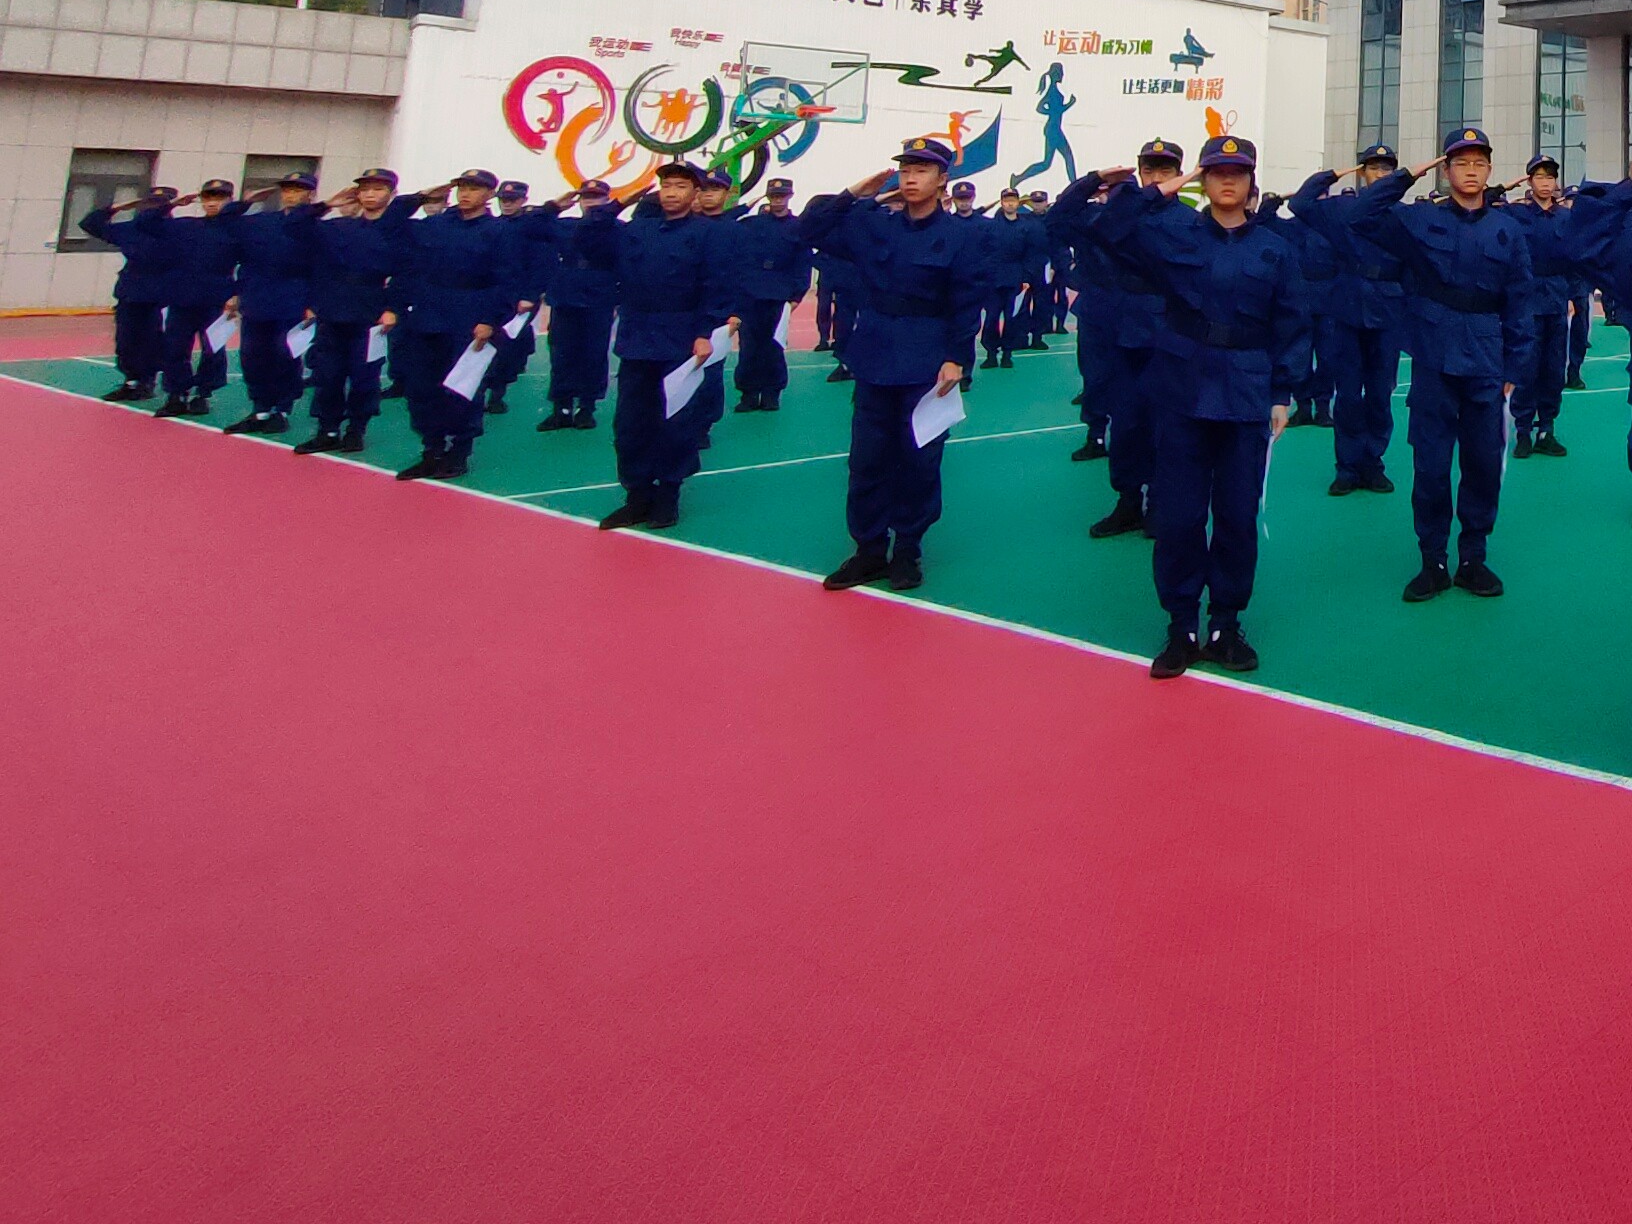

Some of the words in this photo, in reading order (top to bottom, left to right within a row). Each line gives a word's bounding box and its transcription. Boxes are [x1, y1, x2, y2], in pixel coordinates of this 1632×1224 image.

[589, 36, 629, 50] 我运动
[595, 47, 625, 58] Sports
